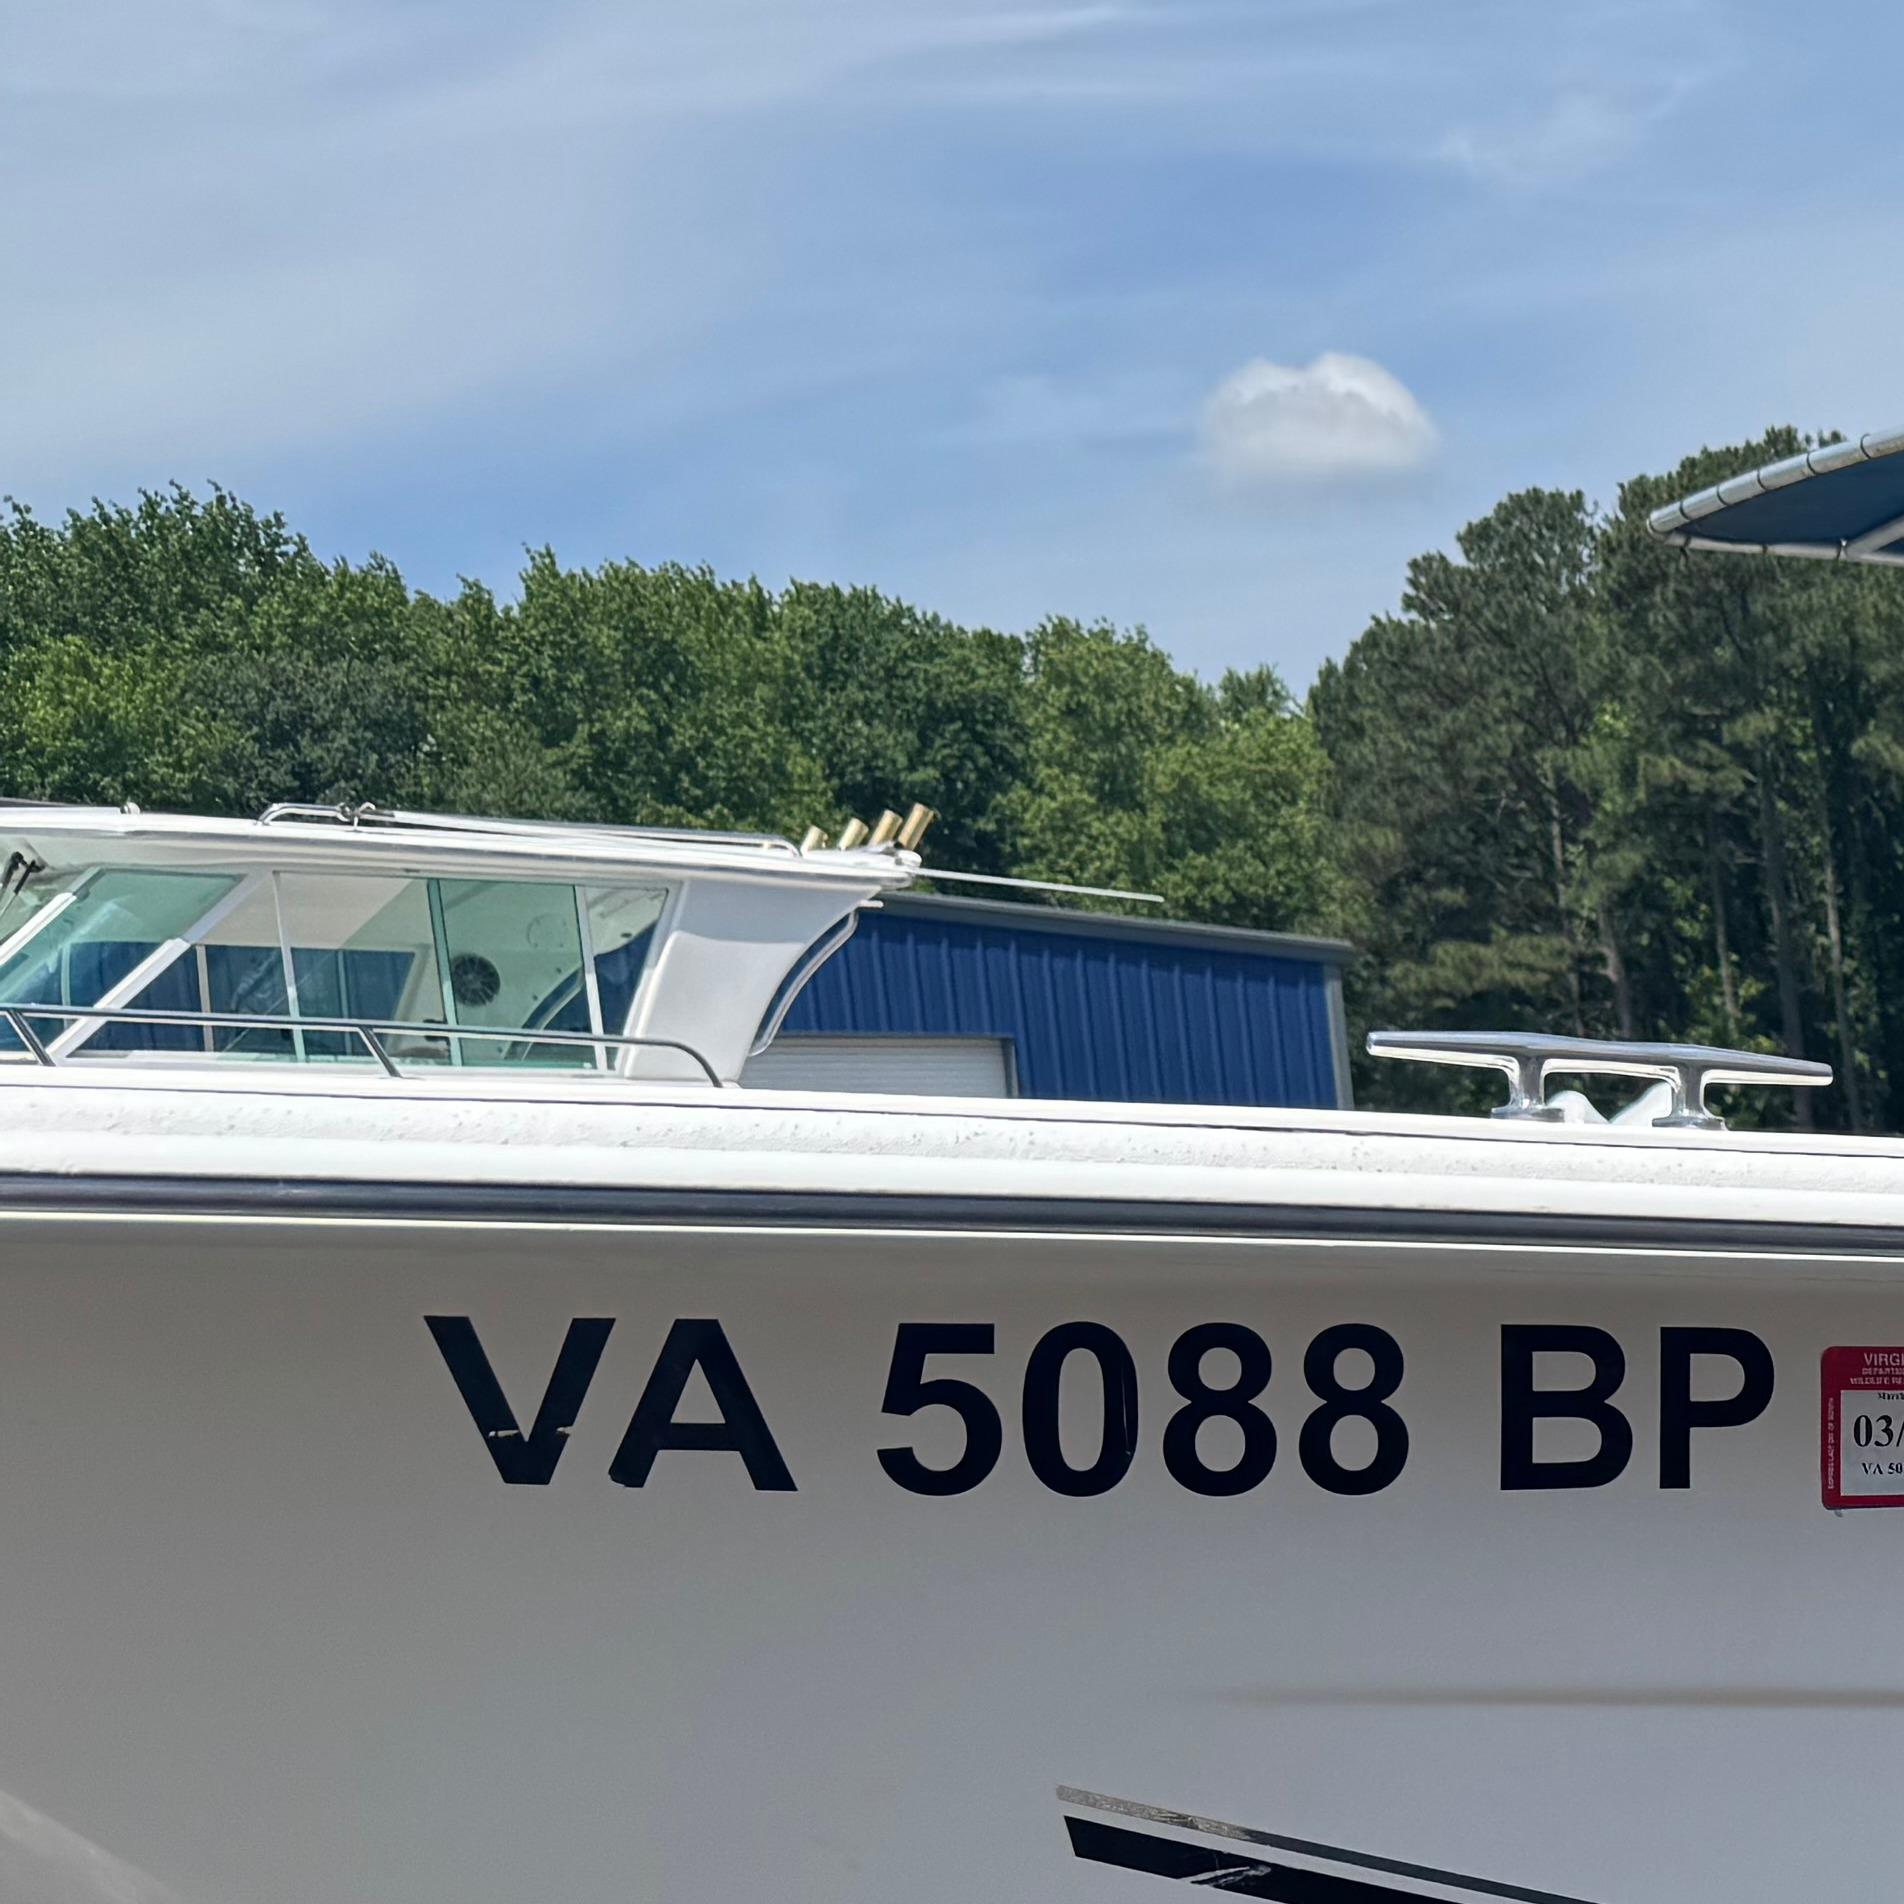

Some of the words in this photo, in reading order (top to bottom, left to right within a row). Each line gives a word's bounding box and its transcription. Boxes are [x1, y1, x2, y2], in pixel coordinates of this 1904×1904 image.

[425, 1316, 796, 1491] VA
[878, 1322, 1409, 1497] 5088
[1501, 1324, 1774, 1490] BP
[1861, 1462, 1883, 1475] VA
